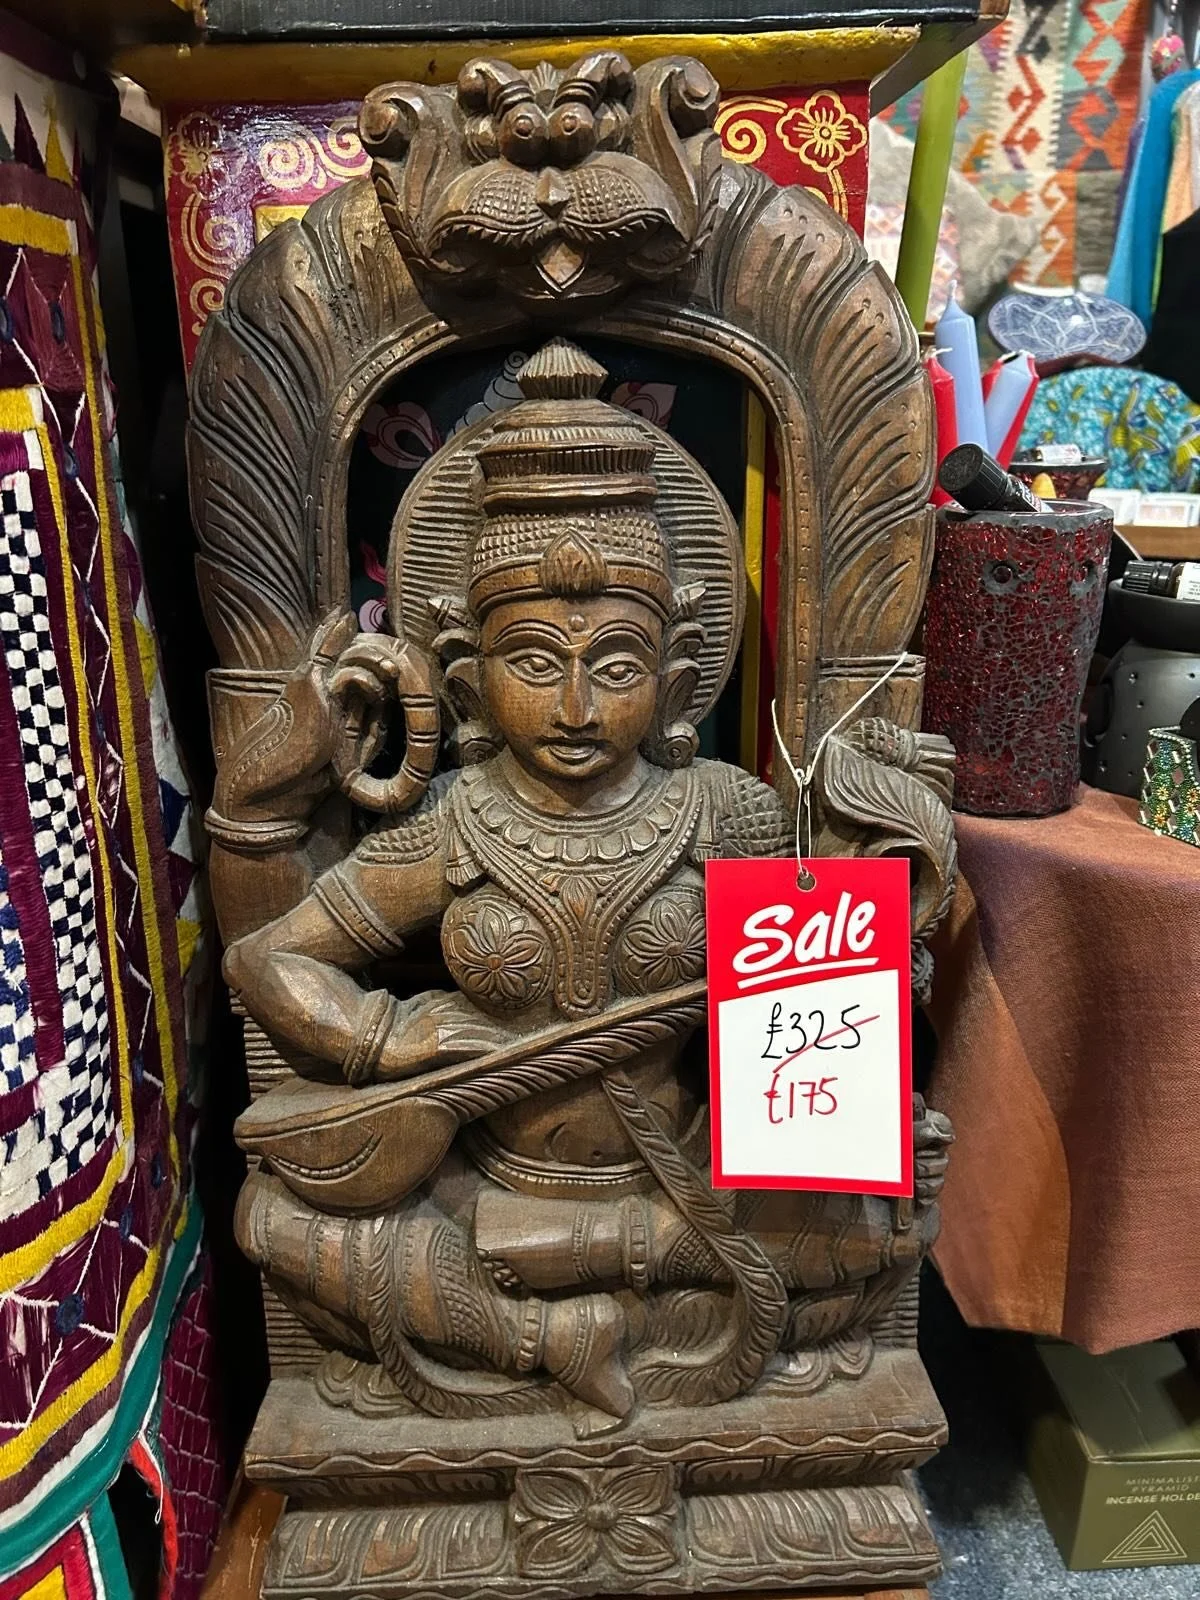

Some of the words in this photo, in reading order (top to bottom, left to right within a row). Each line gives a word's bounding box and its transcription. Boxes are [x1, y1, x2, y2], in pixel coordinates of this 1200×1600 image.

[732, 891, 876, 974] Sale
[761, 1002, 862, 1060] £325
[763, 1073, 839, 1125] £175
[1105, 1494, 1158, 1505] INCENSE
[1131, 1484, 1190, 1493] PYRAMID
